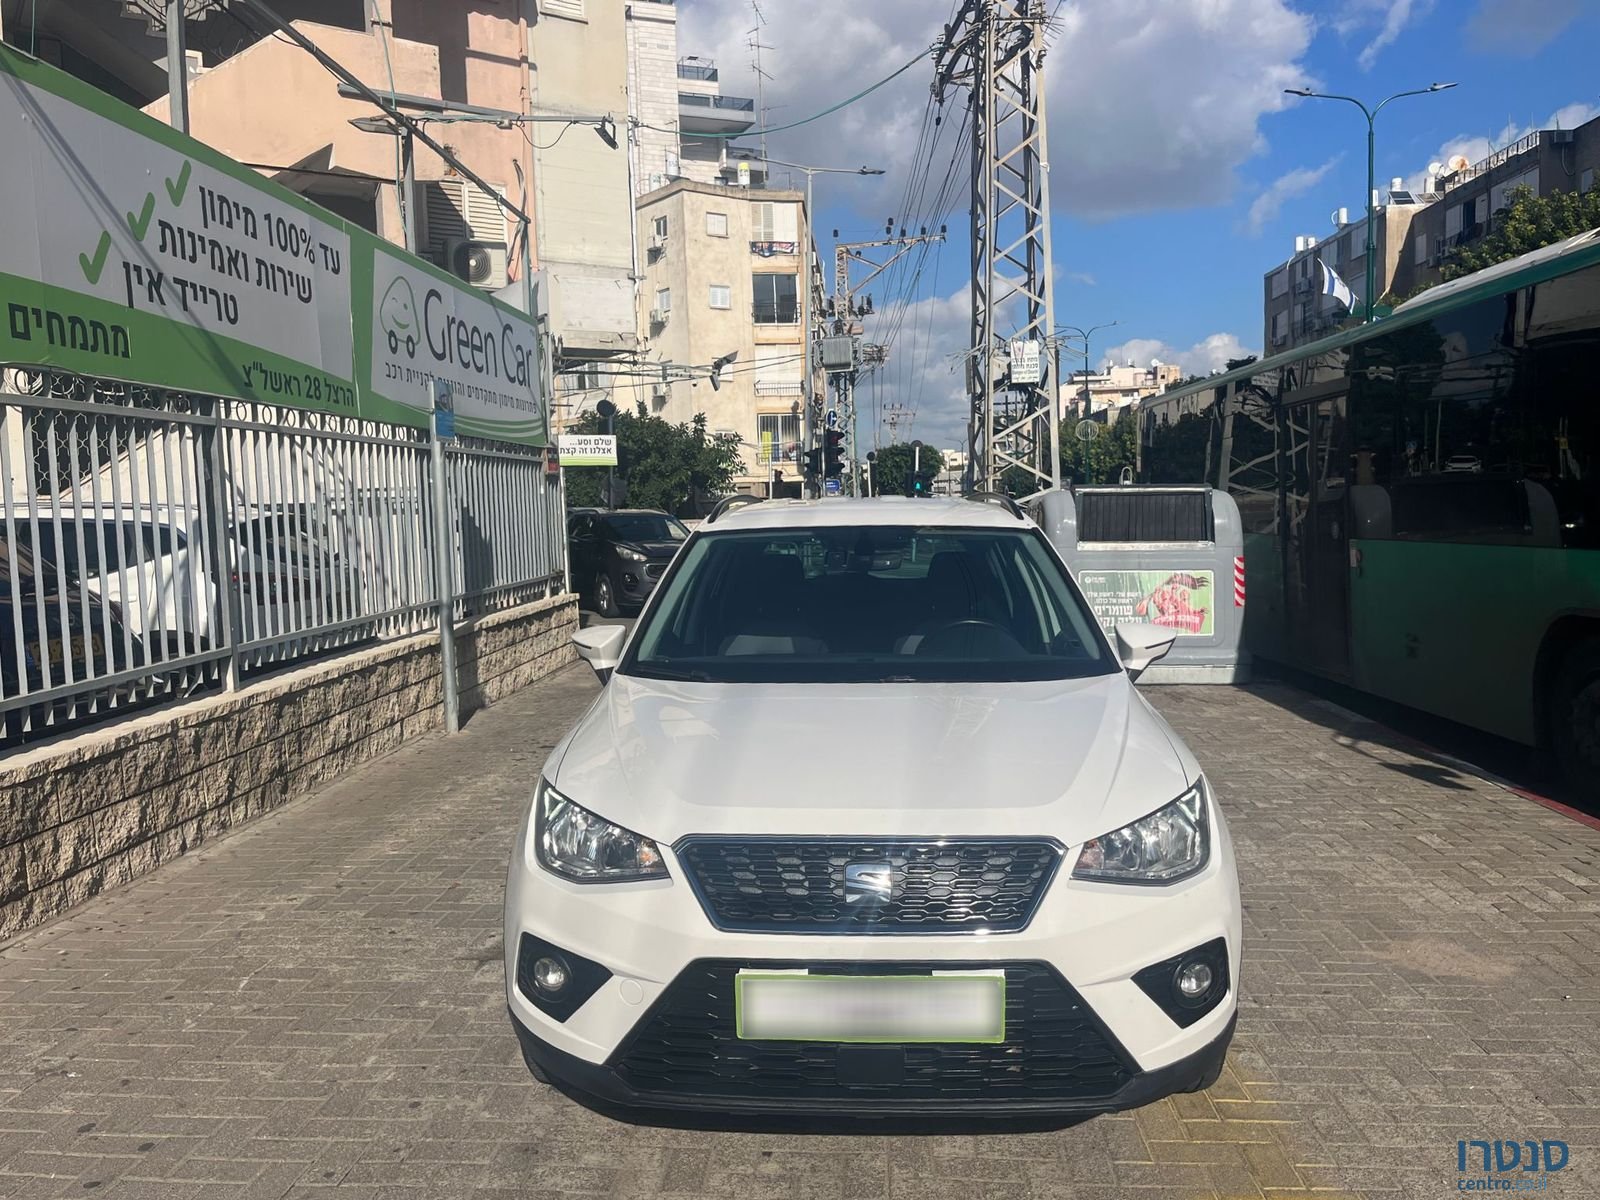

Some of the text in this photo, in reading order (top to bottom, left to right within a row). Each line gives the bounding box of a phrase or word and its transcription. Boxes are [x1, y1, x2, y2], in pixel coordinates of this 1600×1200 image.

[199, 185, 341, 275] עד 100% מימון
[158, 218, 313, 304] שירות ואמינות
[122, 261, 239, 325] טרייד אין
[8, 303, 131, 359] מתמחים
[424, 288, 533, 388] Green Car
[385, 362, 403, 382] רכב
[304, 374, 321, 400] 28
[324, 378, 354, 407] הרצל
[560, 447, 577, 456] קצת
[590, 446, 612, 454] אצלנו
[594, 437, 612, 446] שלם
[1094, 605, 1133, 616] שומרים
